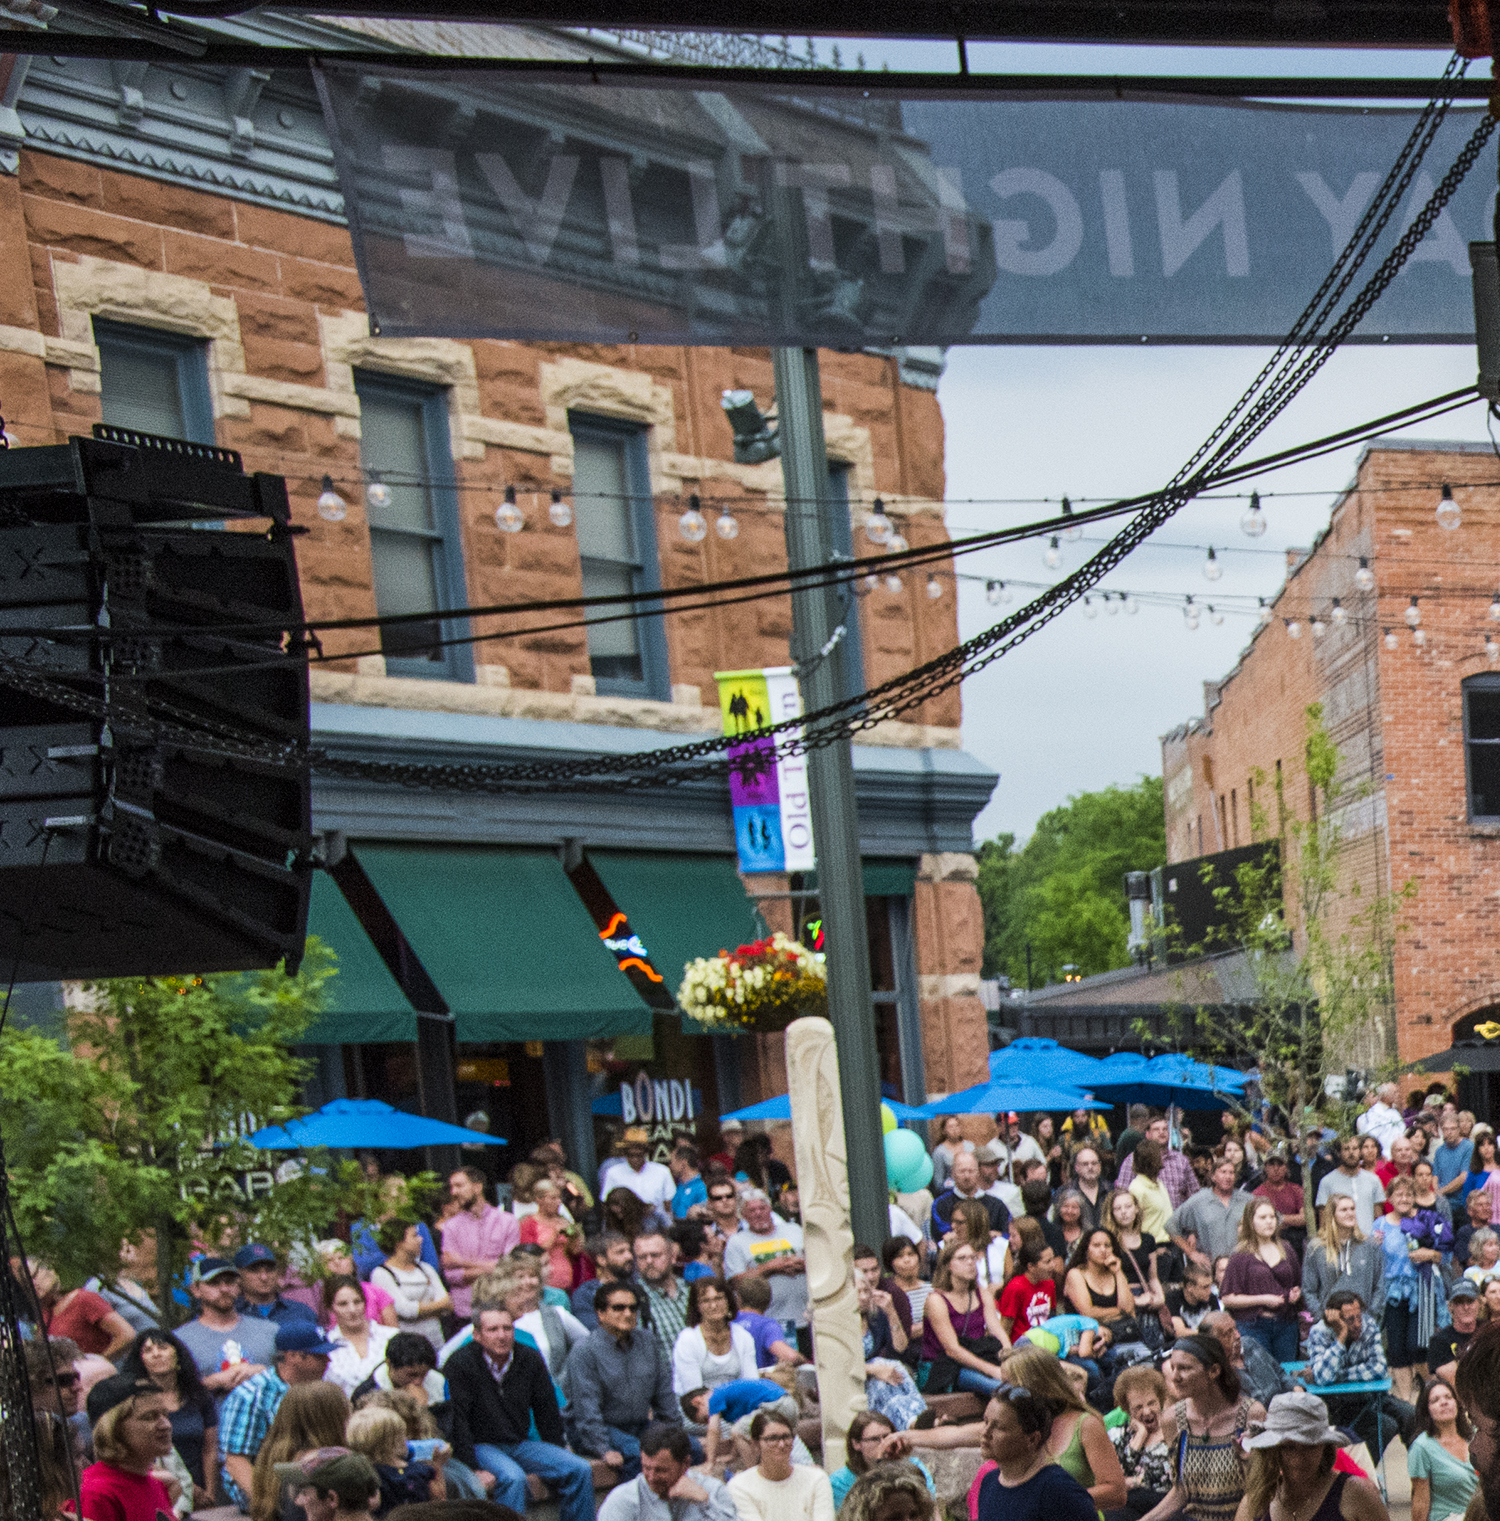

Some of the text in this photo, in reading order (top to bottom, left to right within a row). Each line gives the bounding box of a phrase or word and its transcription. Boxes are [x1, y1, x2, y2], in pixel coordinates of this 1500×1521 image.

[782, 691, 811, 849] Old Tn
[620, 1070, 694, 1124] BONDI
